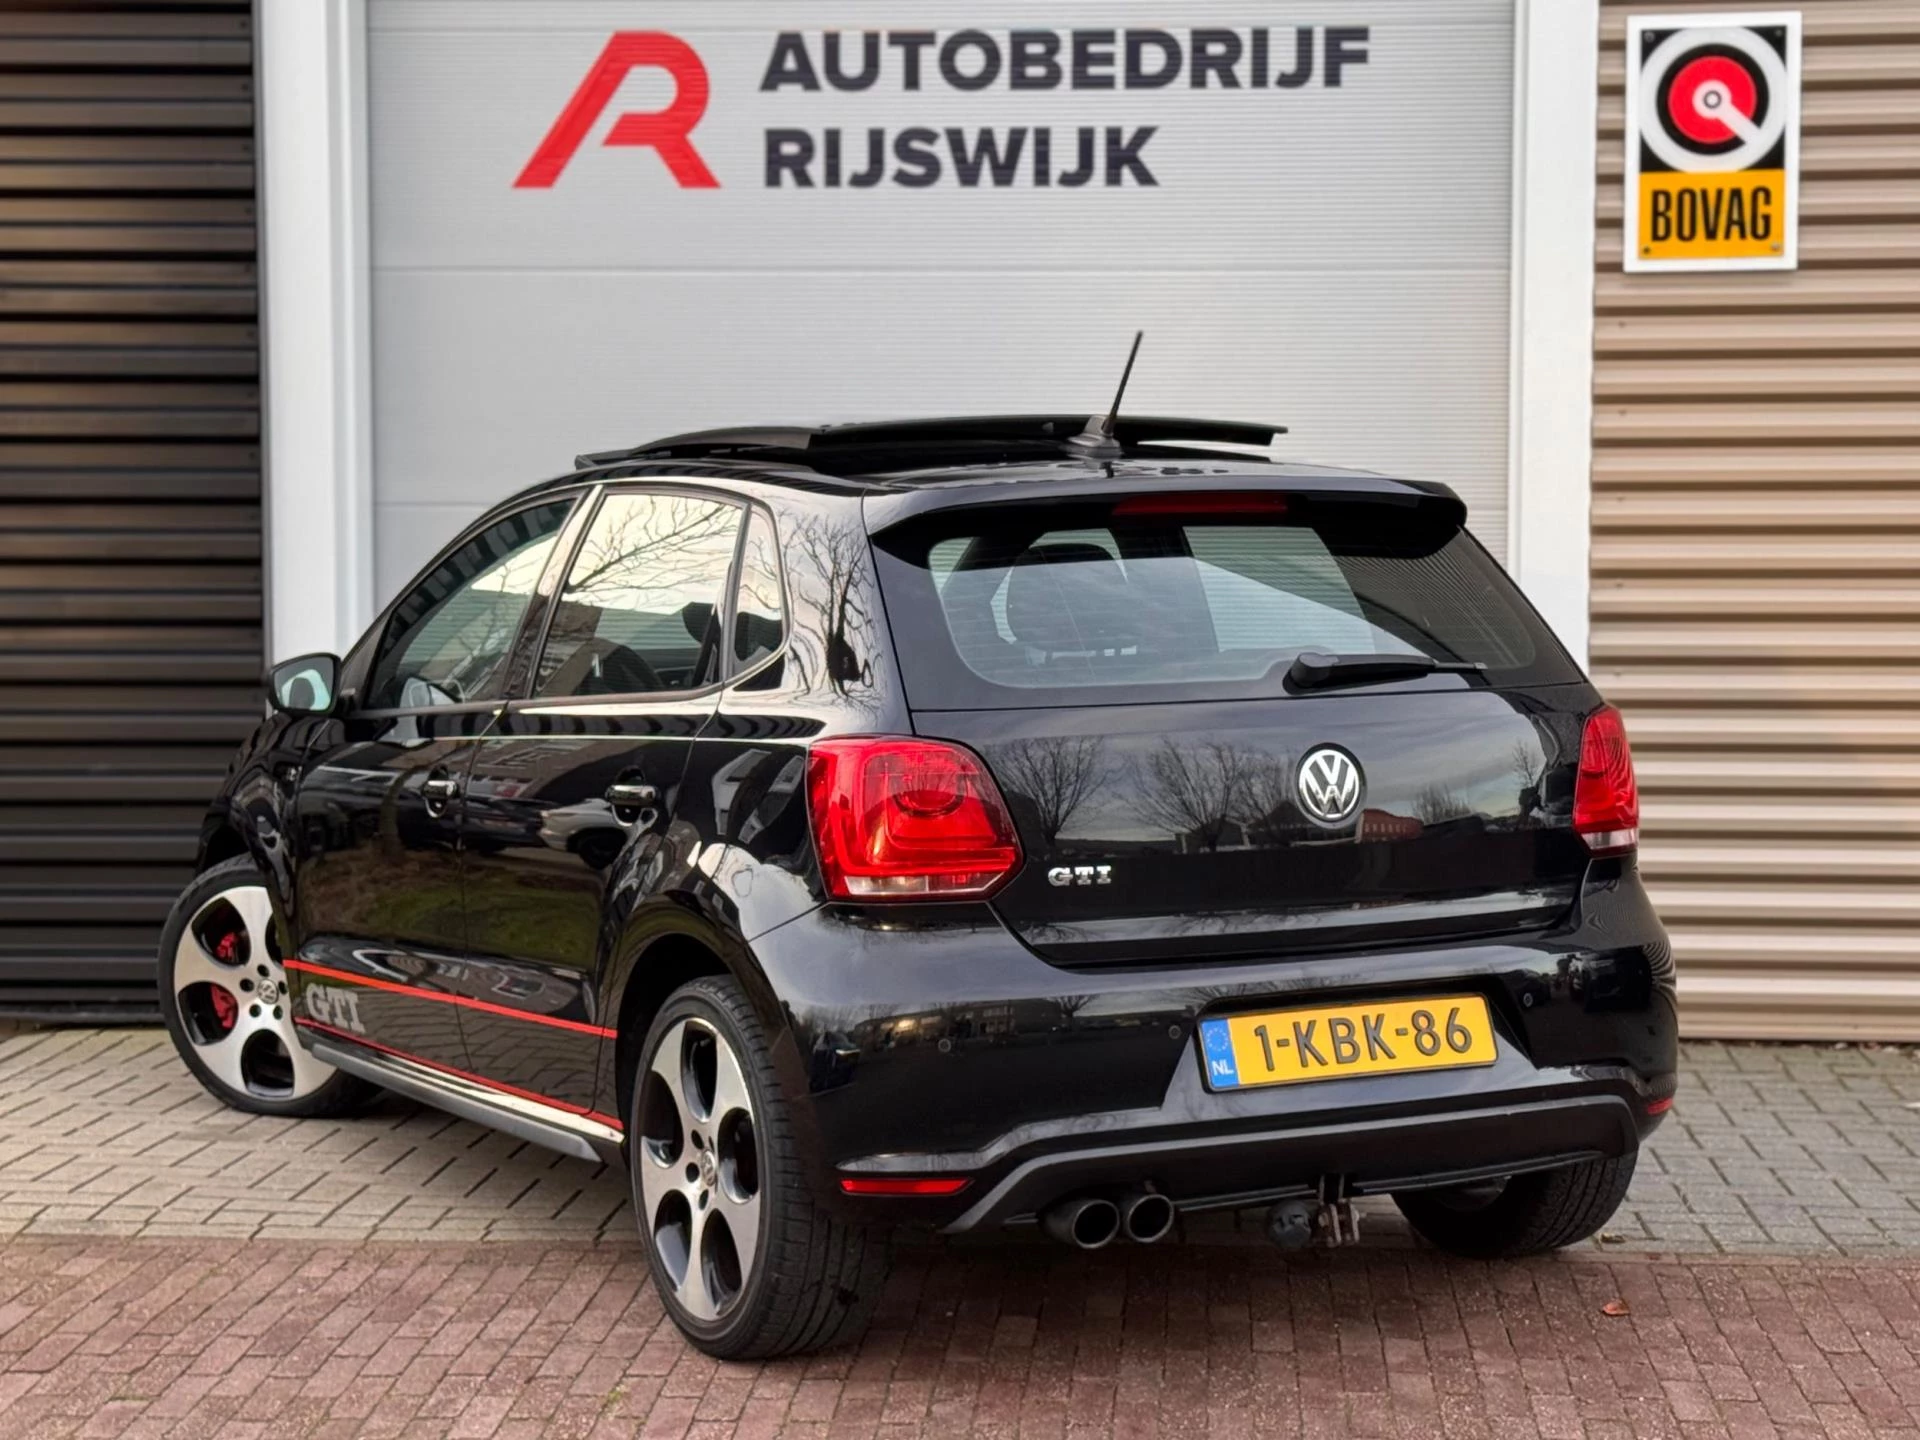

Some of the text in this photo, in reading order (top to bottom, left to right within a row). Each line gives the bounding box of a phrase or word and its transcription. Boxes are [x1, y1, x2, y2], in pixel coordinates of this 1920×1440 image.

[760, 26, 1369, 92] AUTOBEDRIJF
[763, 126, 1159, 188] RIJSWIJK
[1651, 186, 1771, 242] BOVAG
[1047, 865, 1112, 887] GTI
[306, 983, 366, 1033] GTI
[1254, 1006, 1473, 1071] 1-KBK-86
[1211, 1060, 1234, 1076] NL
